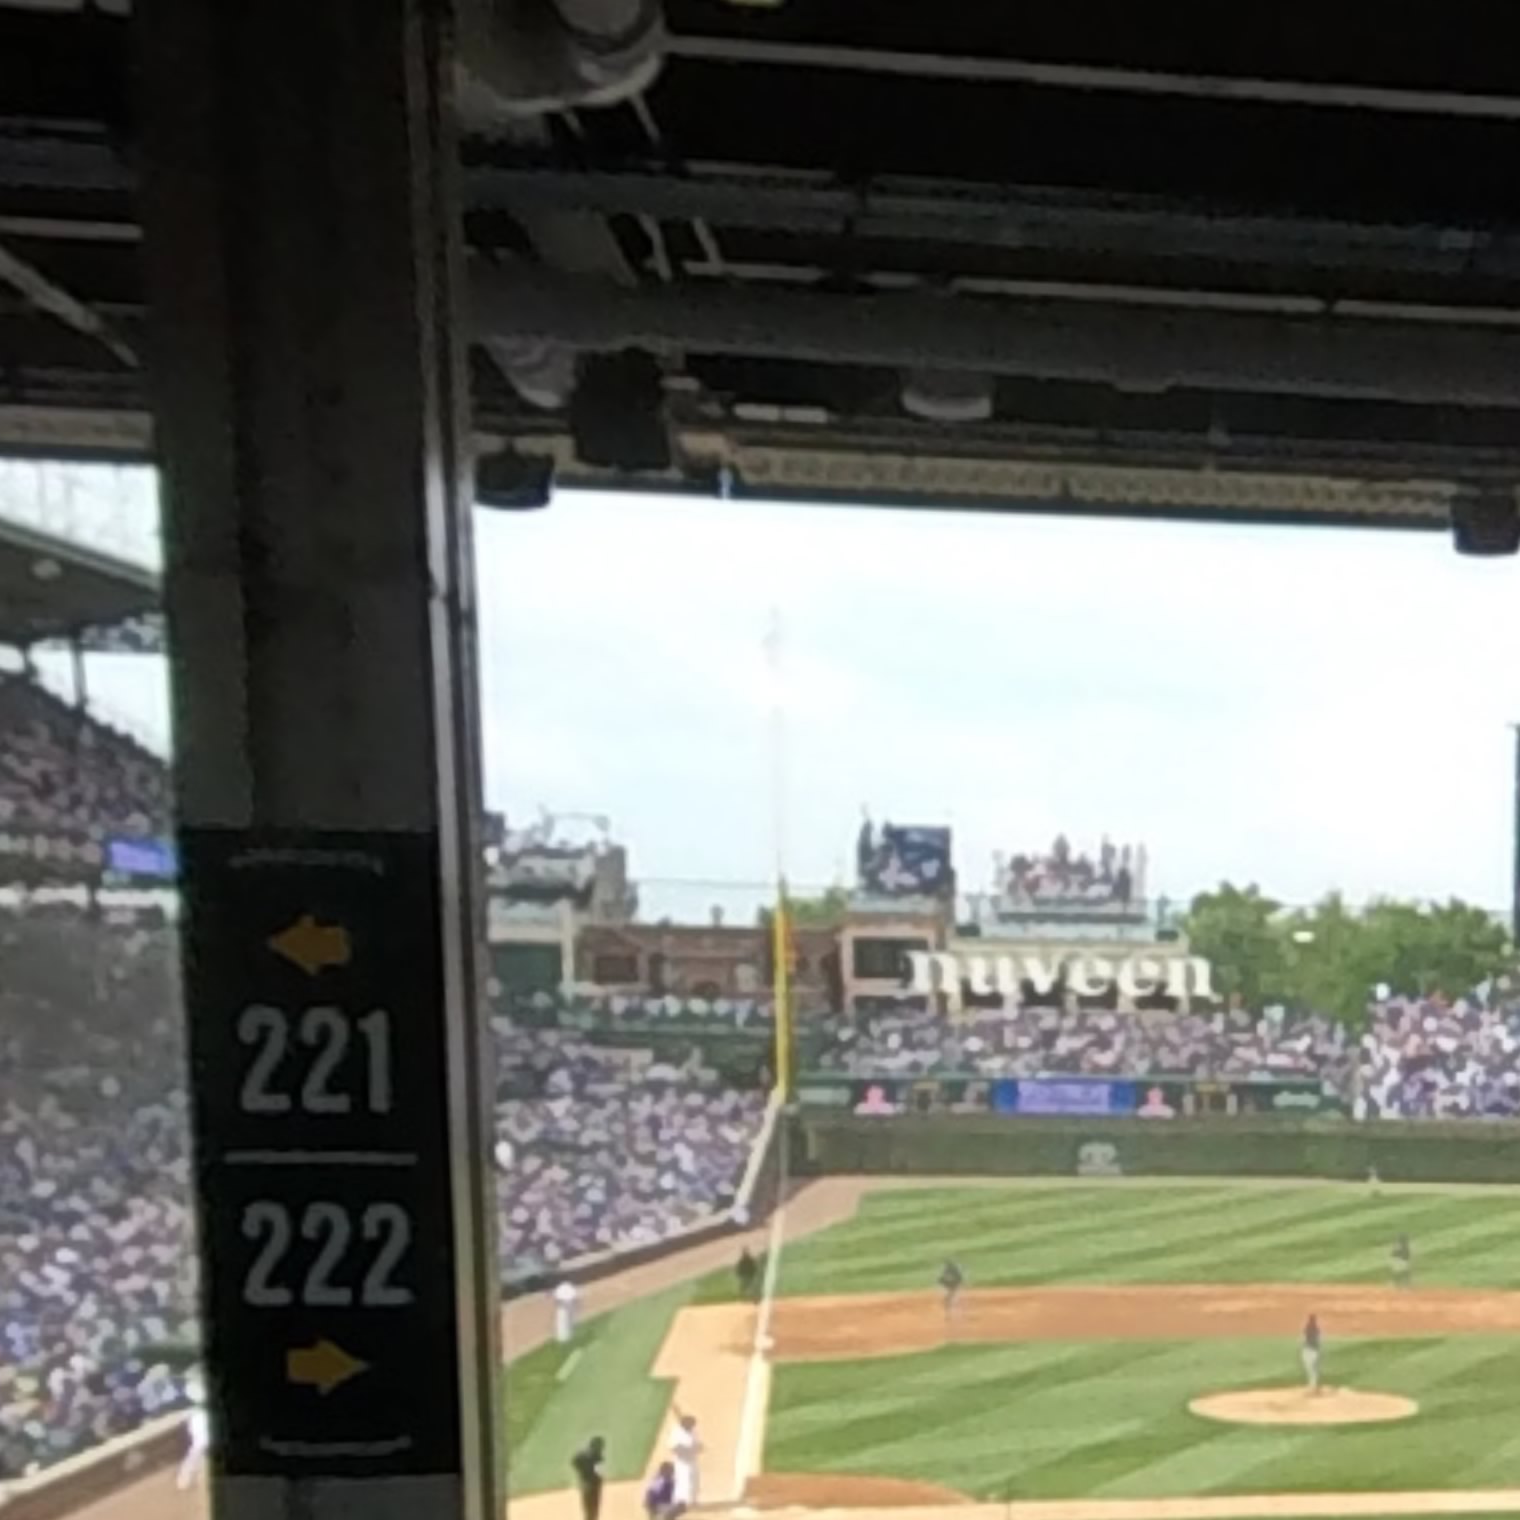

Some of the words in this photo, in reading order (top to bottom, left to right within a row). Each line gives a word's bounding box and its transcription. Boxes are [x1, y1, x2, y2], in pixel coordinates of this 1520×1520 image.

[907, 951, 1223, 1003] nuveen
[236, 1003, 394, 1115] 221
[241, 1201, 417, 1307] 222
